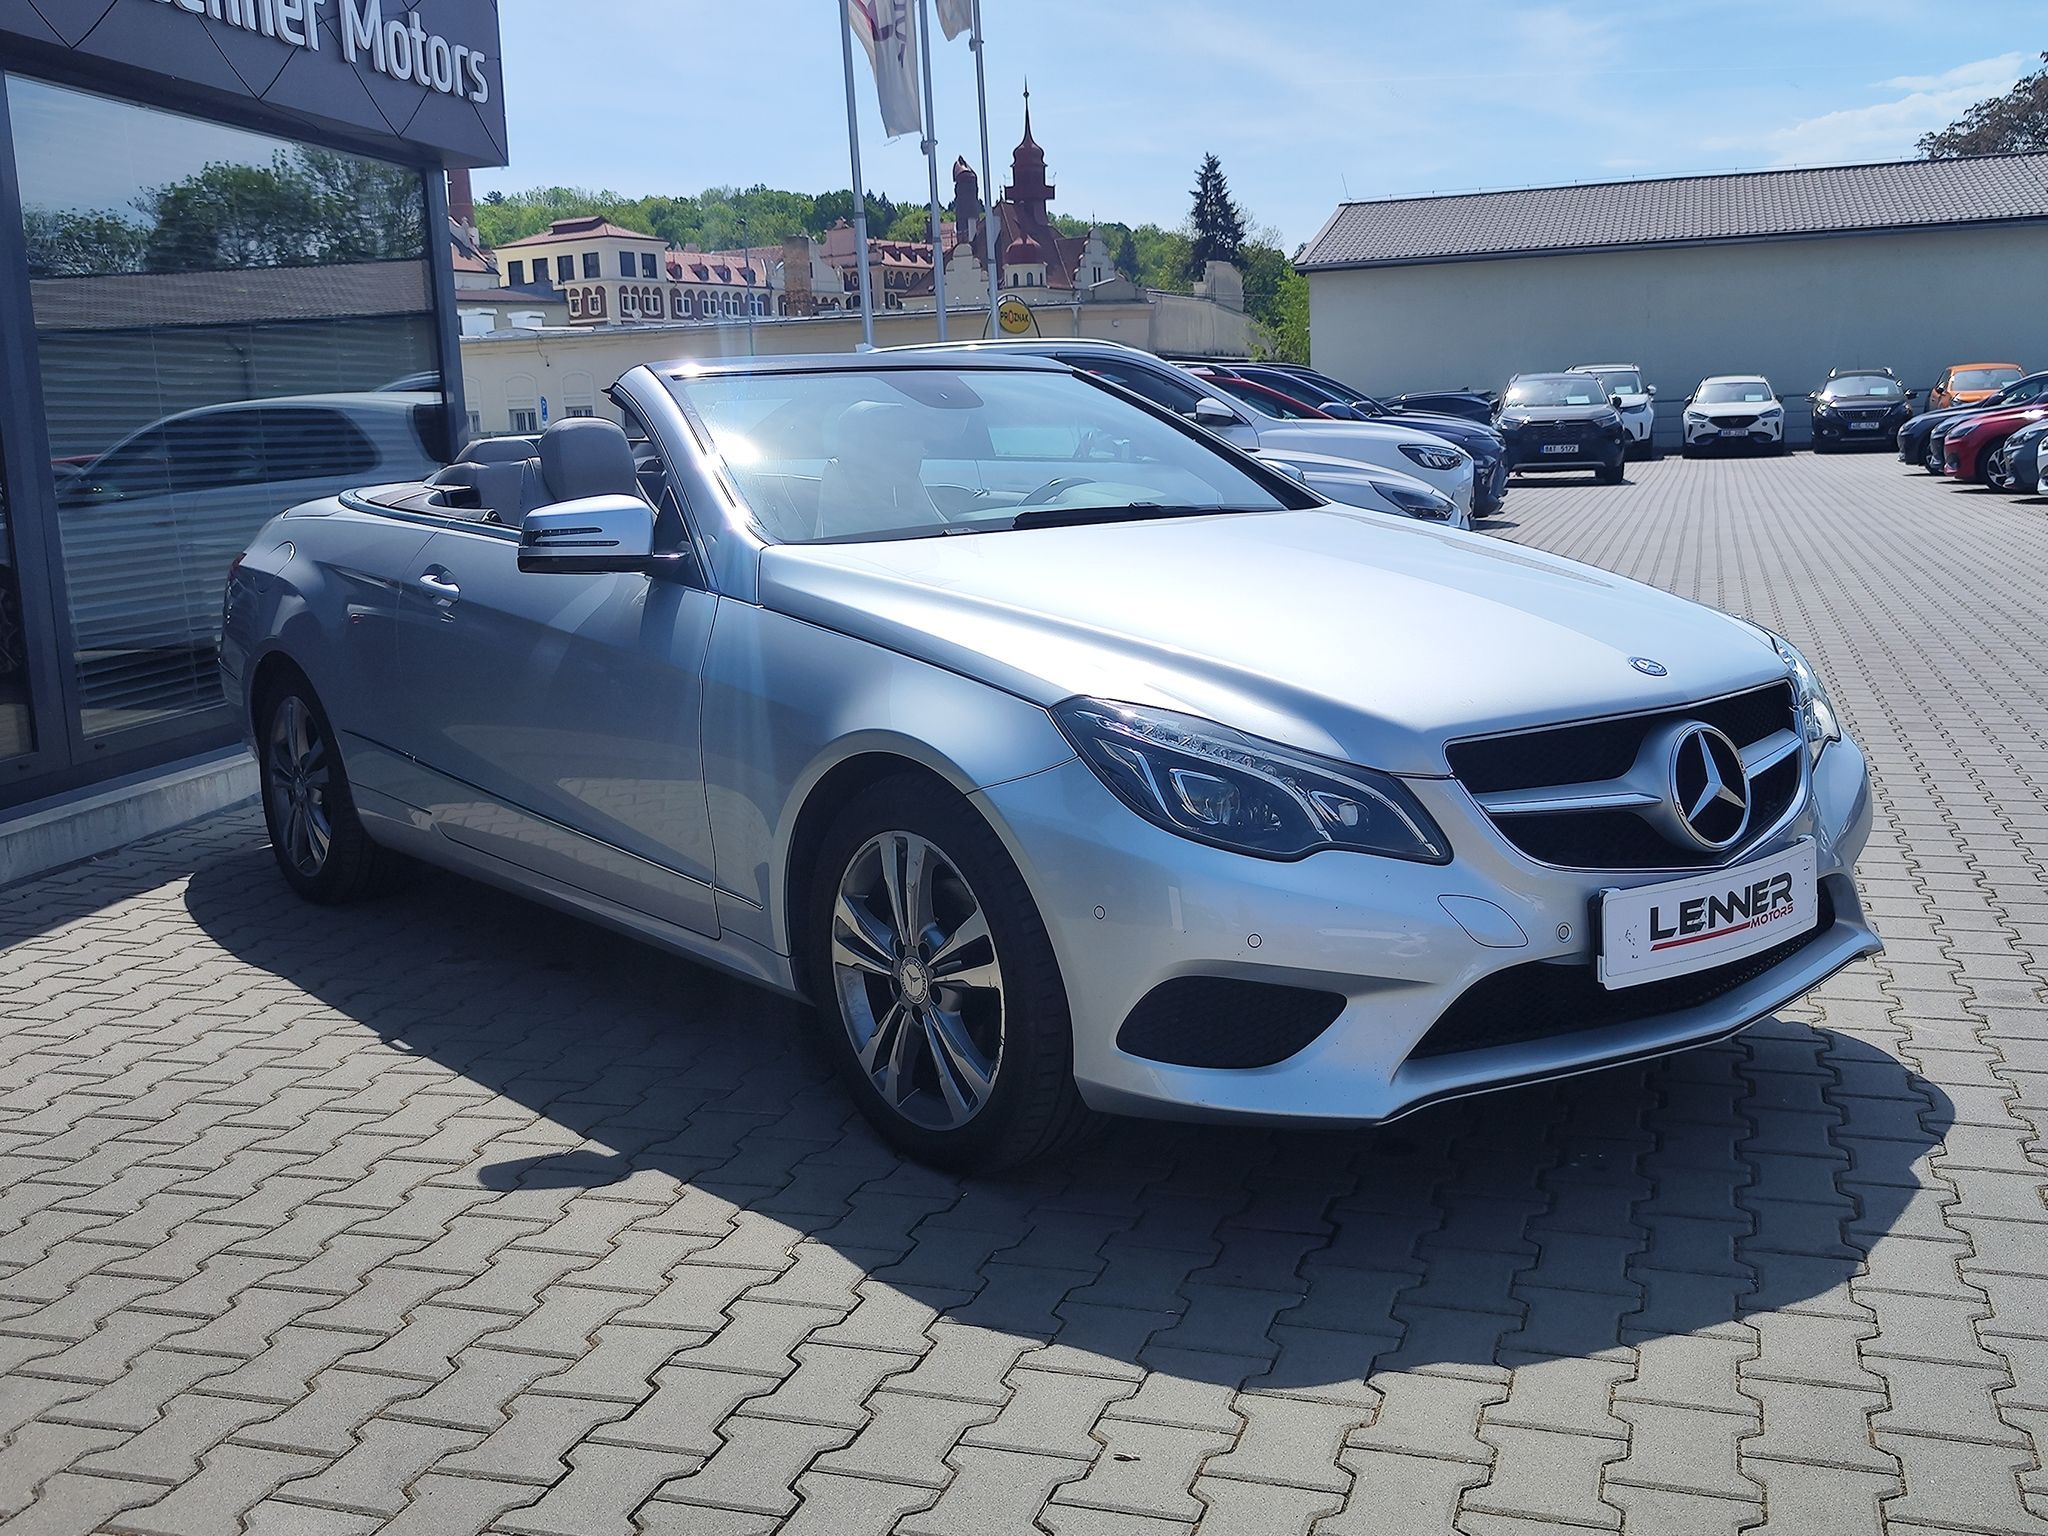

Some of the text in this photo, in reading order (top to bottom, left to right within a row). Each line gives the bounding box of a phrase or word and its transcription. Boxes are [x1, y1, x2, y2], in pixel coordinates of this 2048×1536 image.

[338, 0, 489, 104] Motors
[1650, 872, 1793, 941] LENNER
[1750, 902, 1794, 929] MOTORS
